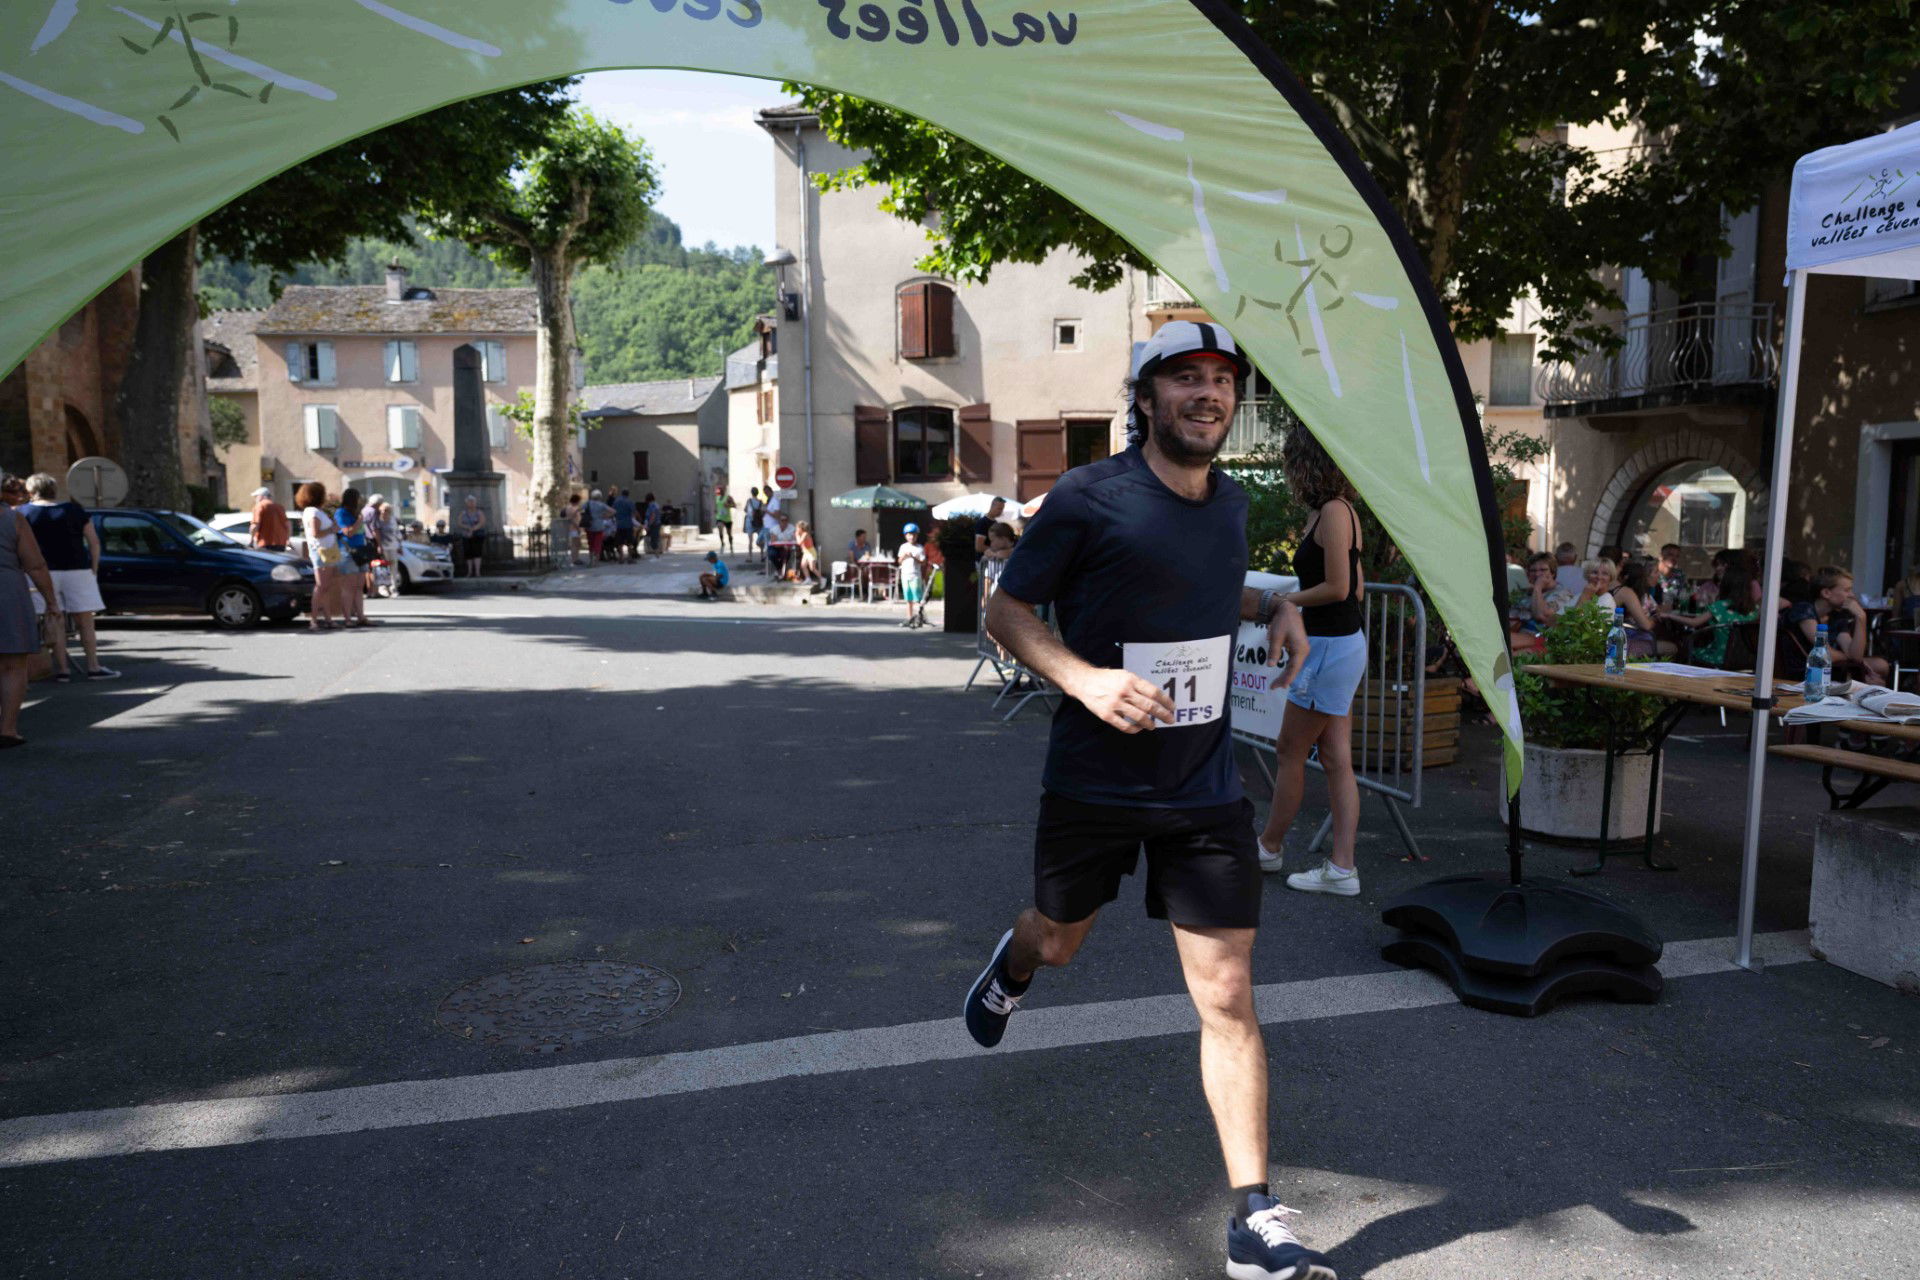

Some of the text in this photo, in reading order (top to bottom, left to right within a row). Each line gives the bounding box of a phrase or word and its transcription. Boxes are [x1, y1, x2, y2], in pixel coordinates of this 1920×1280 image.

[1821, 201, 1905, 228] Challenge
[1811, 217, 1920, 248] vallées céven
[1155, 659, 1194, 668] Challenge
[1163, 675, 1197, 703] 11
[1151, 705, 1213, 722] FF'S
